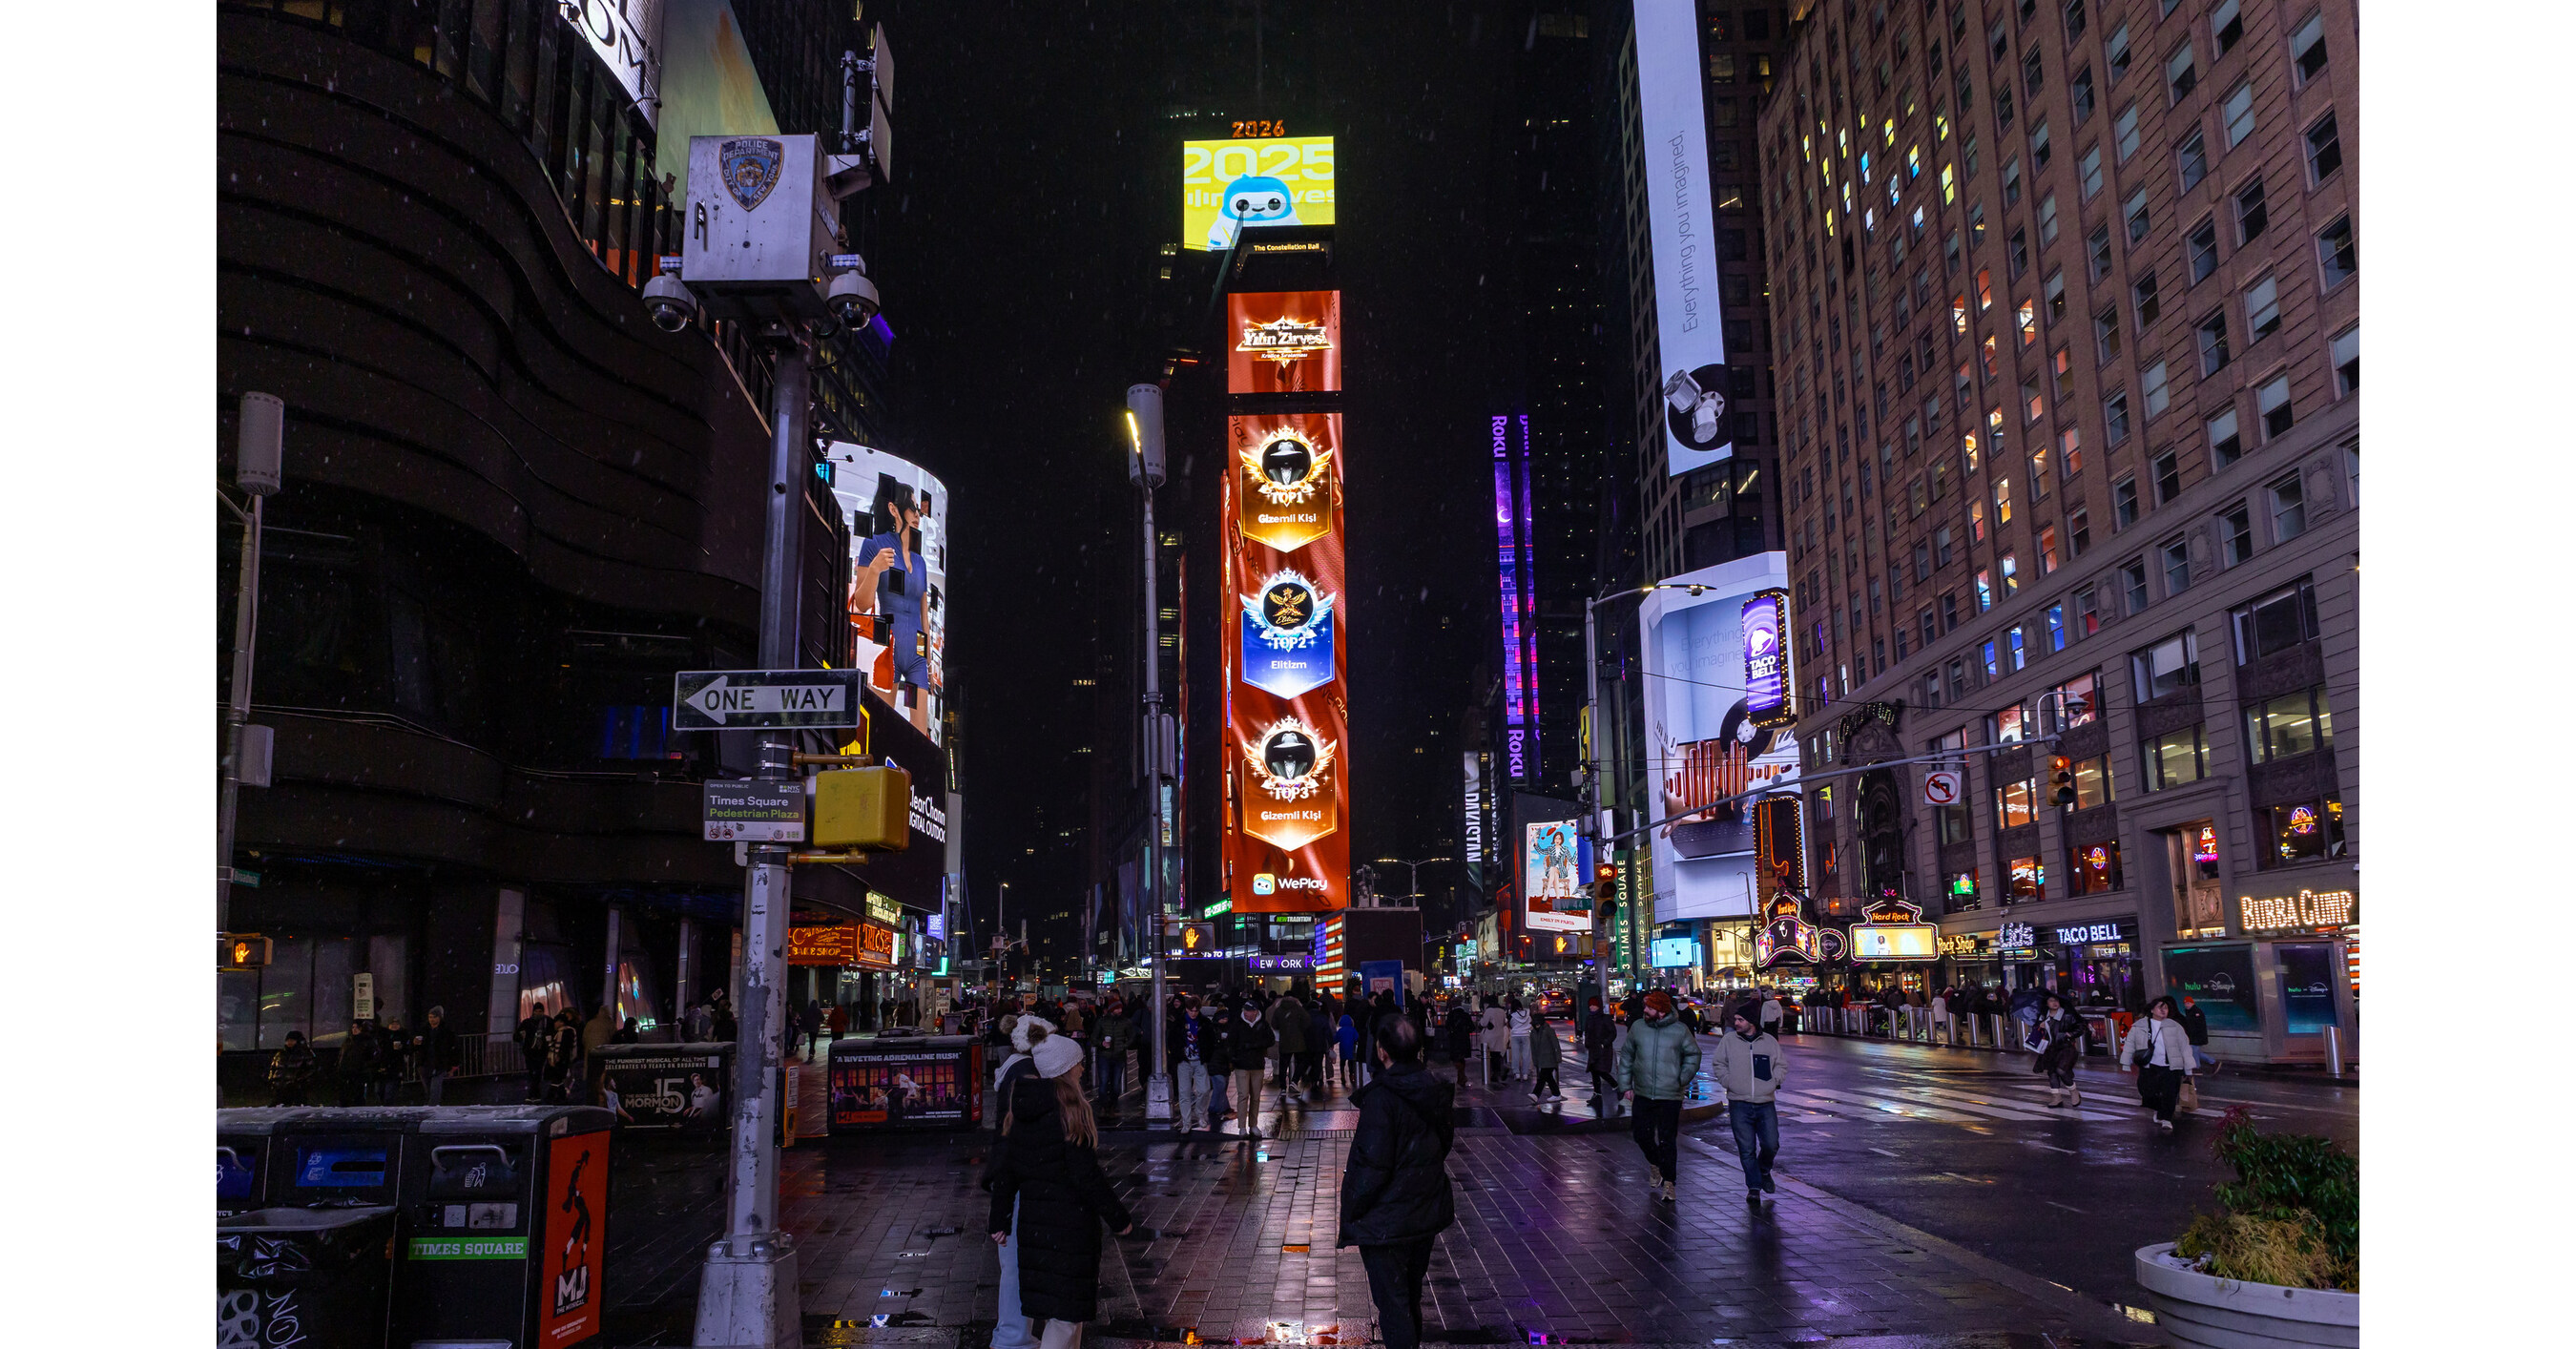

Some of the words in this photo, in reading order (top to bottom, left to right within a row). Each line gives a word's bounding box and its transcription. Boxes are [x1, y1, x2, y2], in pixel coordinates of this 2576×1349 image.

[1232, 119, 1285, 137] 2026
[735, 140, 768, 150] POLICE
[723, 148, 779, 160] DEPARTMENT
[1184, 144, 1334, 184] 2025
[1668, 130, 1690, 212] imagined,
[724, 169, 735, 186] CITY
[765, 164, 779, 183] YORK
[753, 184, 767, 200] NEW
[1677, 212, 1695, 244] you
[1267, 243, 1307, 252] Constellation
[1678, 244, 1699, 334] Everything
[1271, 492, 1304, 505] TOP1
[1257, 513, 1296, 524] Gizemli
[1271, 636, 1307, 650] TOP2
[1680, 628, 1743, 652] Everything
[1271, 660, 1307, 670] Elitizm
[1671, 661, 1692, 676] you
[1749, 654, 1776, 671] TACO
[1752, 666, 1777, 680] BELL
[704, 689, 755, 711] ONE
[780, 688, 835, 710] WAY
[1273, 787, 1309, 800] TOP3
[710, 795, 745, 805] Times
[747, 796, 789, 808] Square
[710, 808, 769, 819] Pedestrian
[771, 809, 800, 819] Plaza
[1260, 810, 1300, 821] Gizemli
[909, 810, 925, 834] IGITAL
[1278, 878, 1328, 891] WePlay
[1617, 860, 1628, 907] SQUARE
[1563, 901, 1569, 909] W
[1573, 901, 1584, 909] 44
[1872, 912, 1891, 922] Hard
[1892, 912, 1910, 923] Rock
[2241, 896, 2300, 930] BUBBA
[1619, 920, 1631, 956] TIMES
[2000, 922, 2034, 948] Lids
[2057, 927, 2088, 944] TACO
[2089, 924, 2121, 942] BELL
[792, 946, 816, 956] BAKE
[817, 946, 841, 956] SHOP
[1937, 937, 1955, 954] Rock
[1955, 935, 1975, 953] Shop
[1250, 956, 1274, 968] NEW
[1275, 955, 1302, 968] YORK
[2184, 982, 2201, 991] hulu
[843, 1054, 883, 1063] RIVETING
[883, 1053, 934, 1062] ADRENALINE
[625, 1097, 679, 1108] MORMON
[654, 1078, 685, 1114] 15
[413, 1243, 461, 1256] TIMES
[465, 1242, 524, 1256] SQUARE
[557, 1265, 587, 1307] MJ
